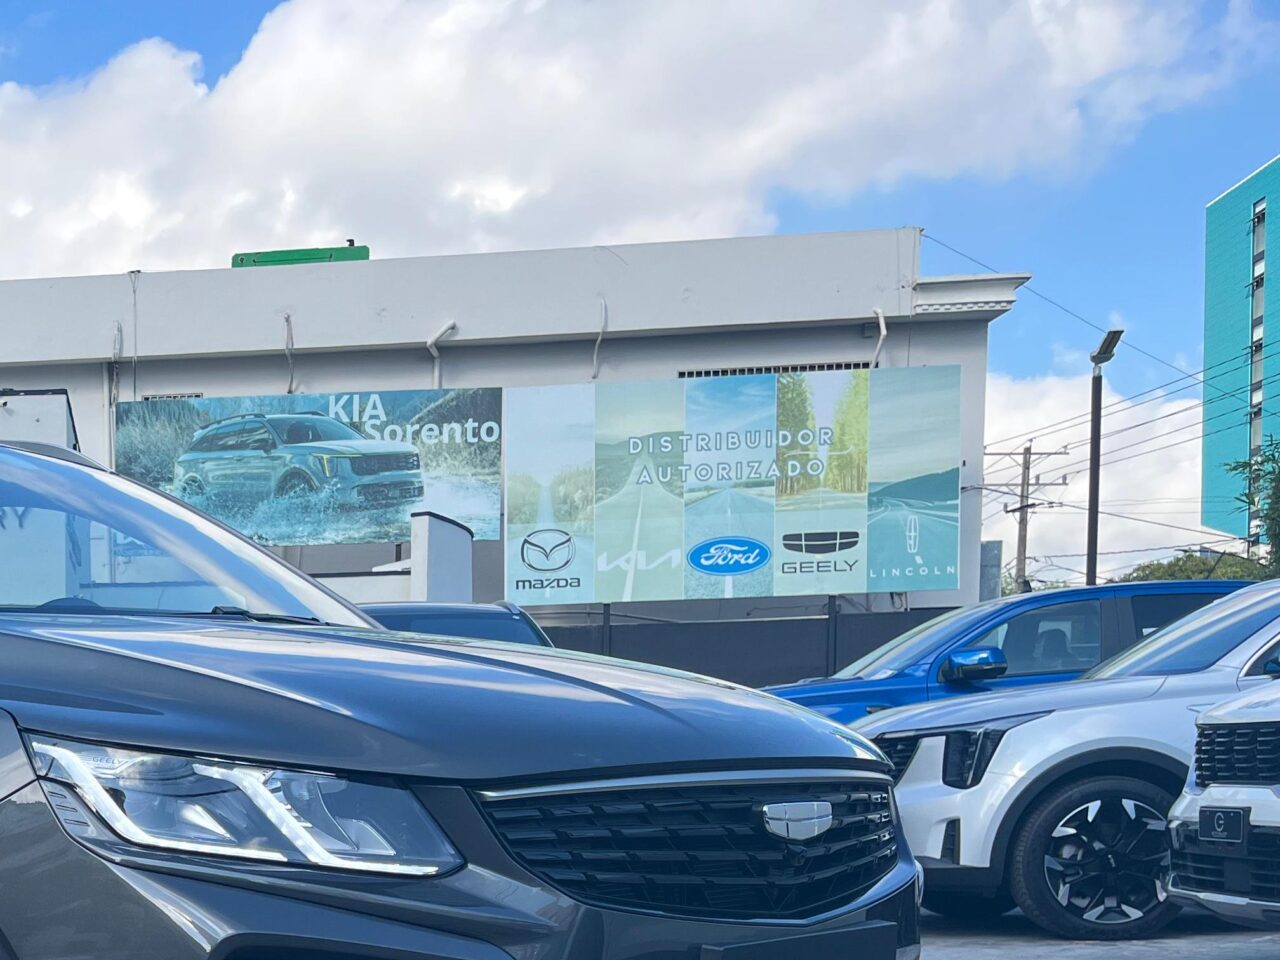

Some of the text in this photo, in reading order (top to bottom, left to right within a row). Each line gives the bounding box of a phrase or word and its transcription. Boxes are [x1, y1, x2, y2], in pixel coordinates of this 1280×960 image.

[329, 394, 387, 422] KIA
[364, 418, 500, 445] Sorento
[629, 426, 833, 455] DISTRIBUIDOR
[636, 459, 824, 485] AUTORIZADO
[700, 543, 760, 566] Ford
[782, 559, 859, 574] GEELY
[869, 565, 956, 578] LINCOLN
